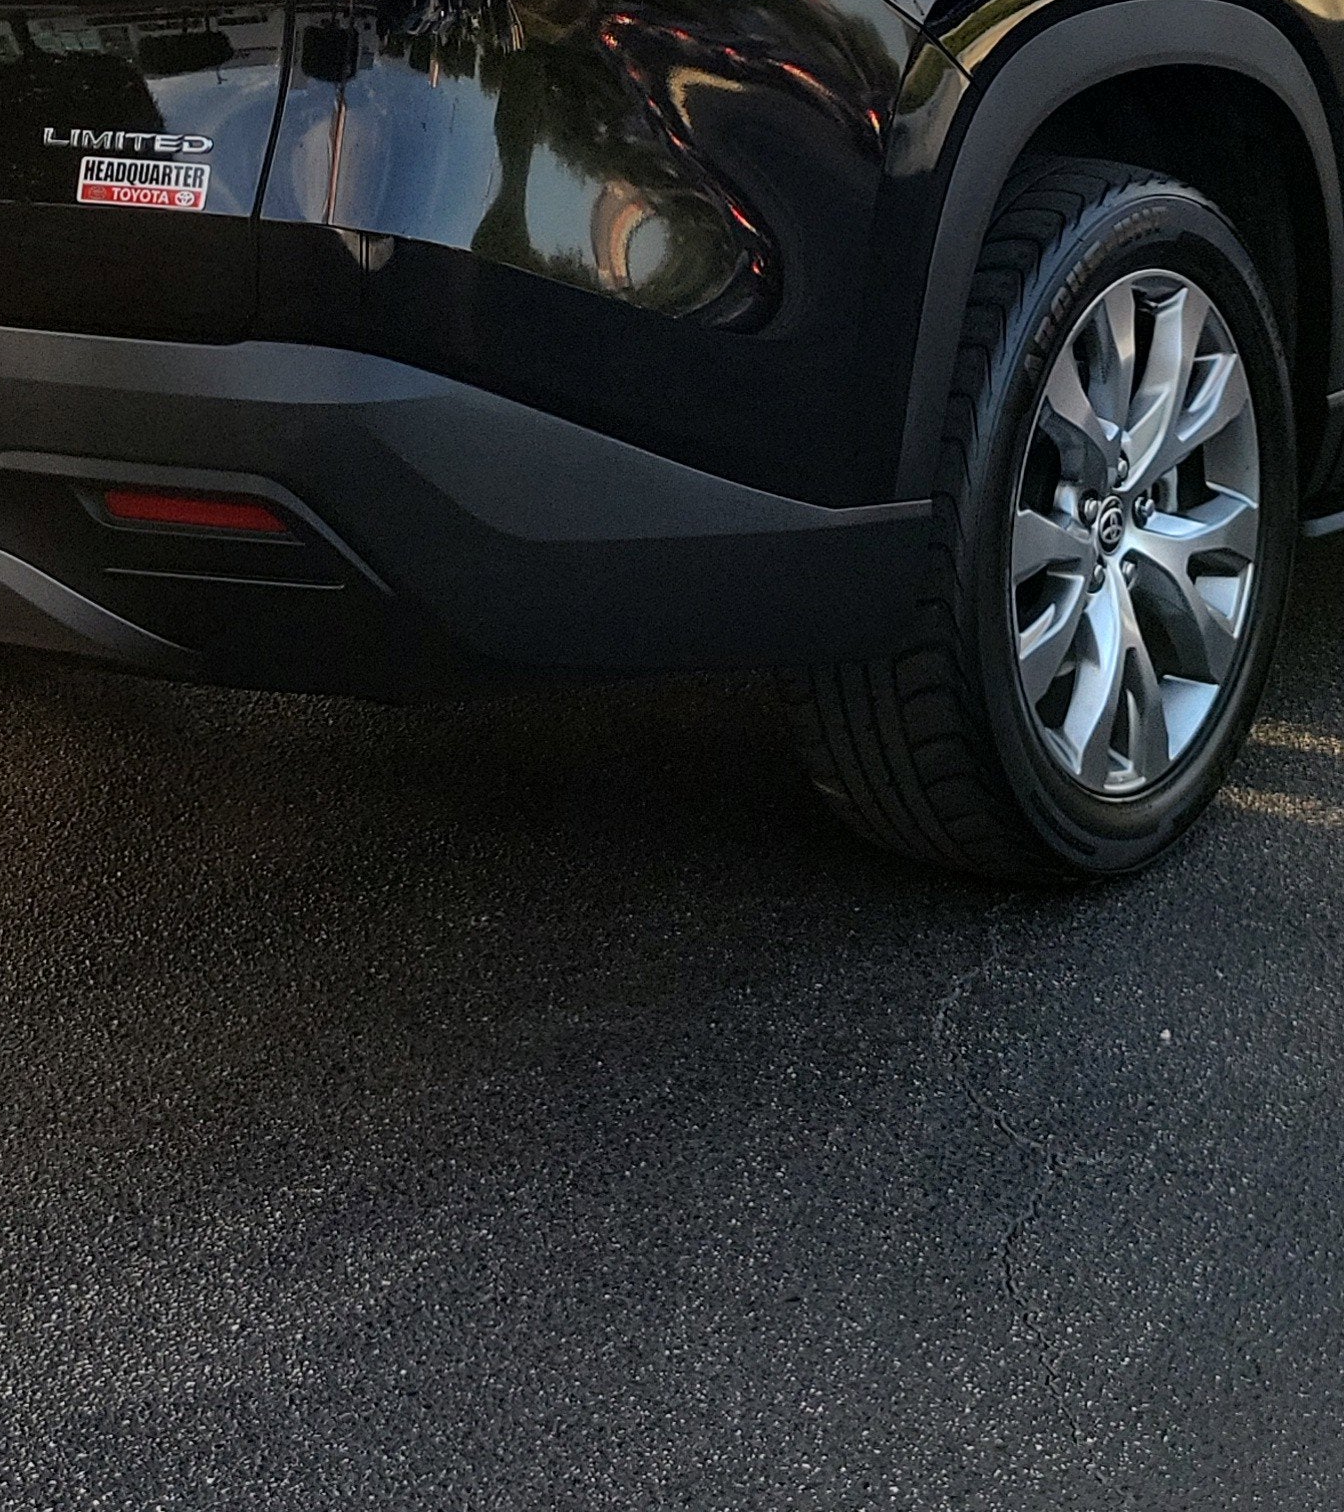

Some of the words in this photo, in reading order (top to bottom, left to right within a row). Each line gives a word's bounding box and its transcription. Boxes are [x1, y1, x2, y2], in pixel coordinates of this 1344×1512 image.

[43, 127, 213, 153] LIMITED
[84, 159, 205, 188] HEADQUARTER
[111, 186, 170, 205] TOYOTA
